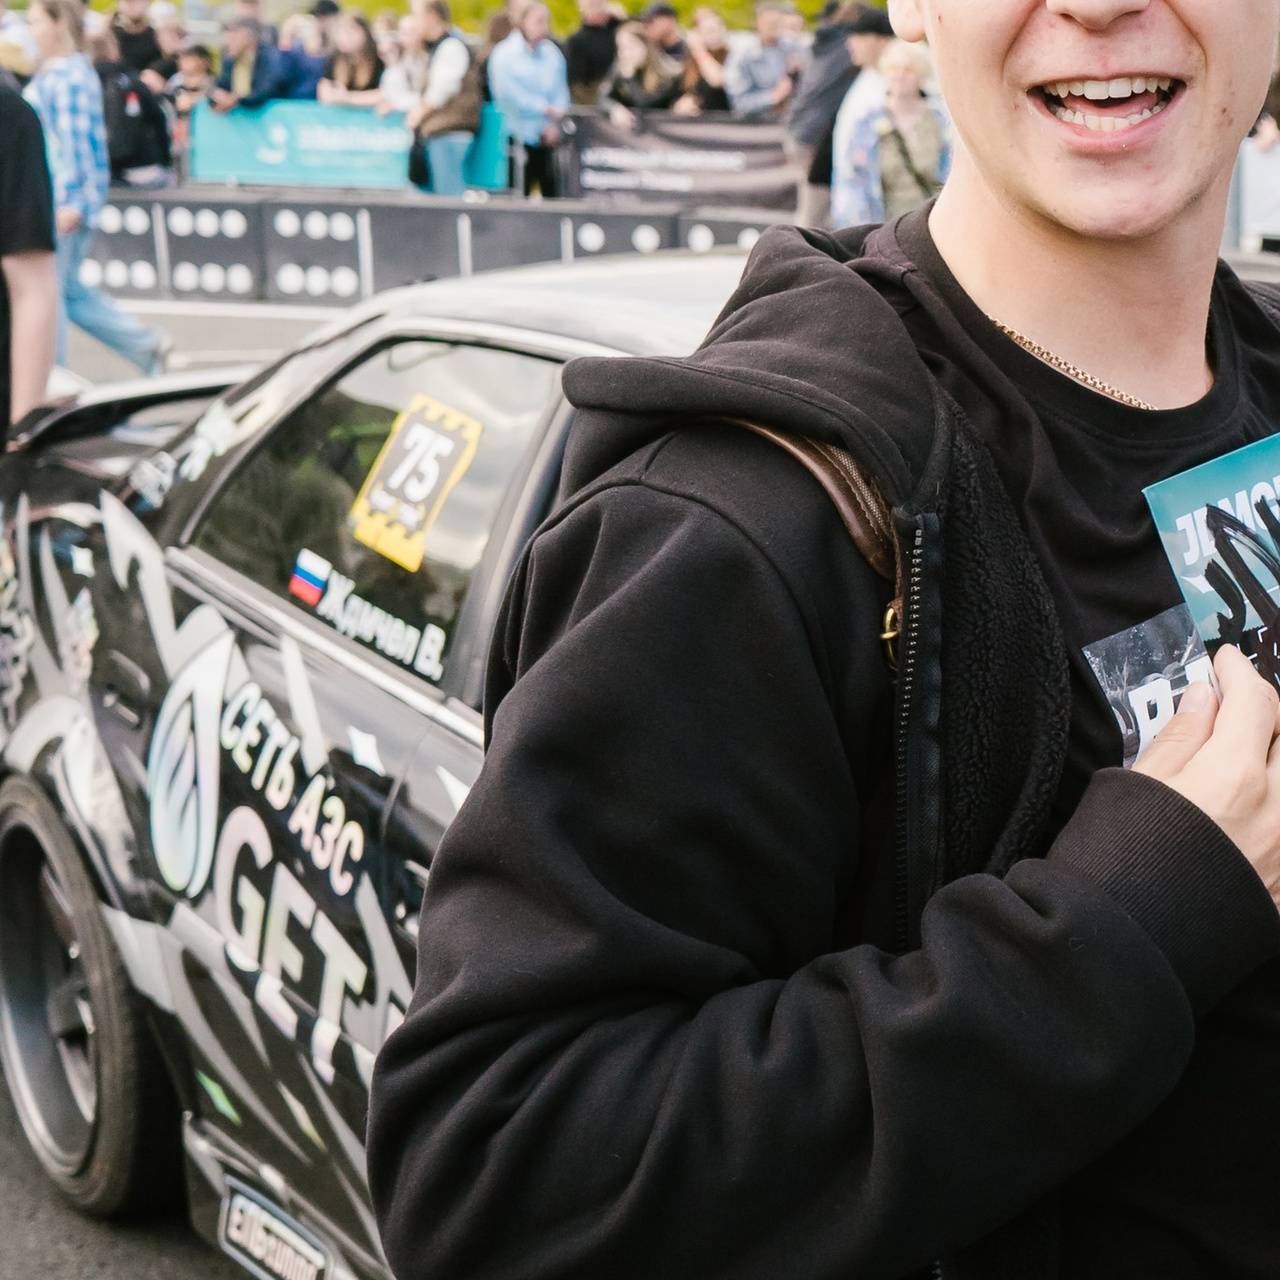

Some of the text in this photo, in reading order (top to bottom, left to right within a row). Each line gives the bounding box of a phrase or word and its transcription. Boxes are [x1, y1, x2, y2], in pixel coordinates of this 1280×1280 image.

[387, 423, 455, 503] 75
[222, 682, 365, 896] СЕТЬ АЗС
[215, 805, 367, 1085] GET
